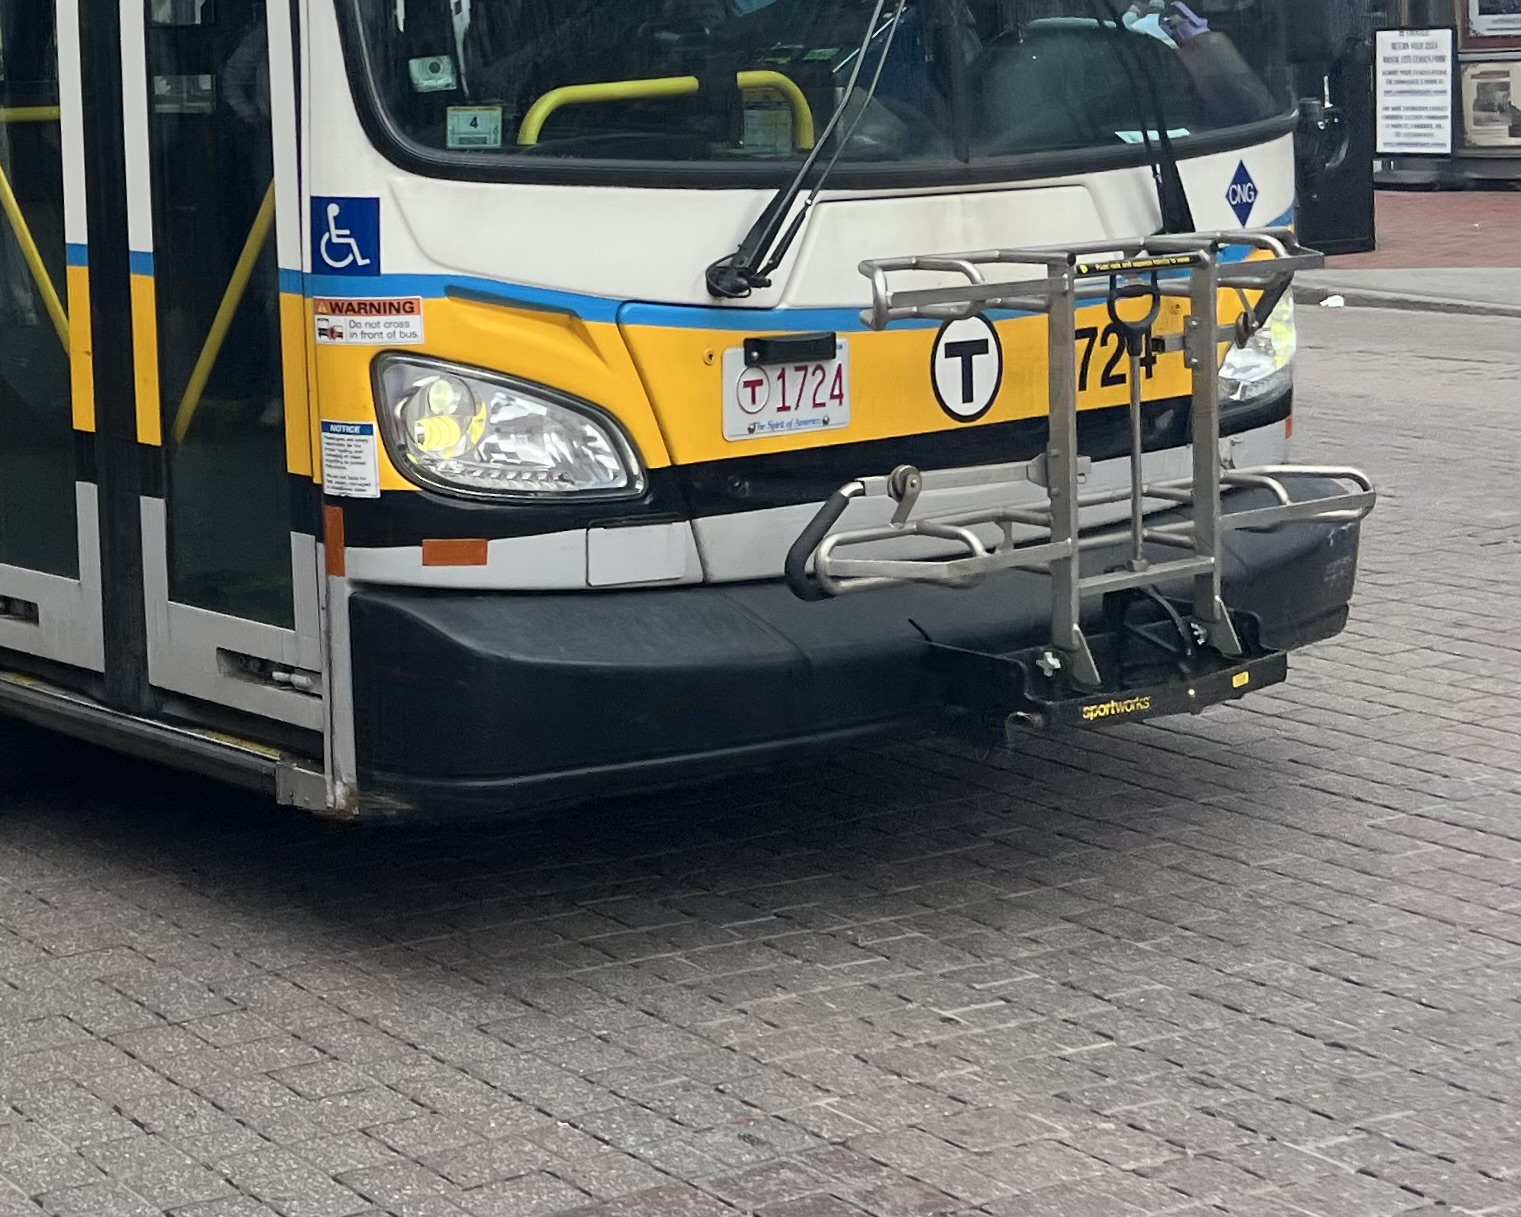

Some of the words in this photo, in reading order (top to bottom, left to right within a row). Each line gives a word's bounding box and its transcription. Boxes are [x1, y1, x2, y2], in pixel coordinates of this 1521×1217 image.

[469, 115, 479, 129] 4
[1228, 182, 1255, 205] CNG
[329, 300, 415, 314] WARNING
[348, 319, 362, 329] Do
[365, 320, 381, 329] not
[383, 320, 410, 329] cross
[349, 331, 357, 339] in
[361, 330, 383, 339] front
[386, 330, 396, 339] of
[944, 338, 989, 405] T
[743, 378, 764, 405] T
[776, 363, 844, 412] 1724
[329, 424, 361, 434] NOTICE
[1082, 695, 1151, 721] sportworks
